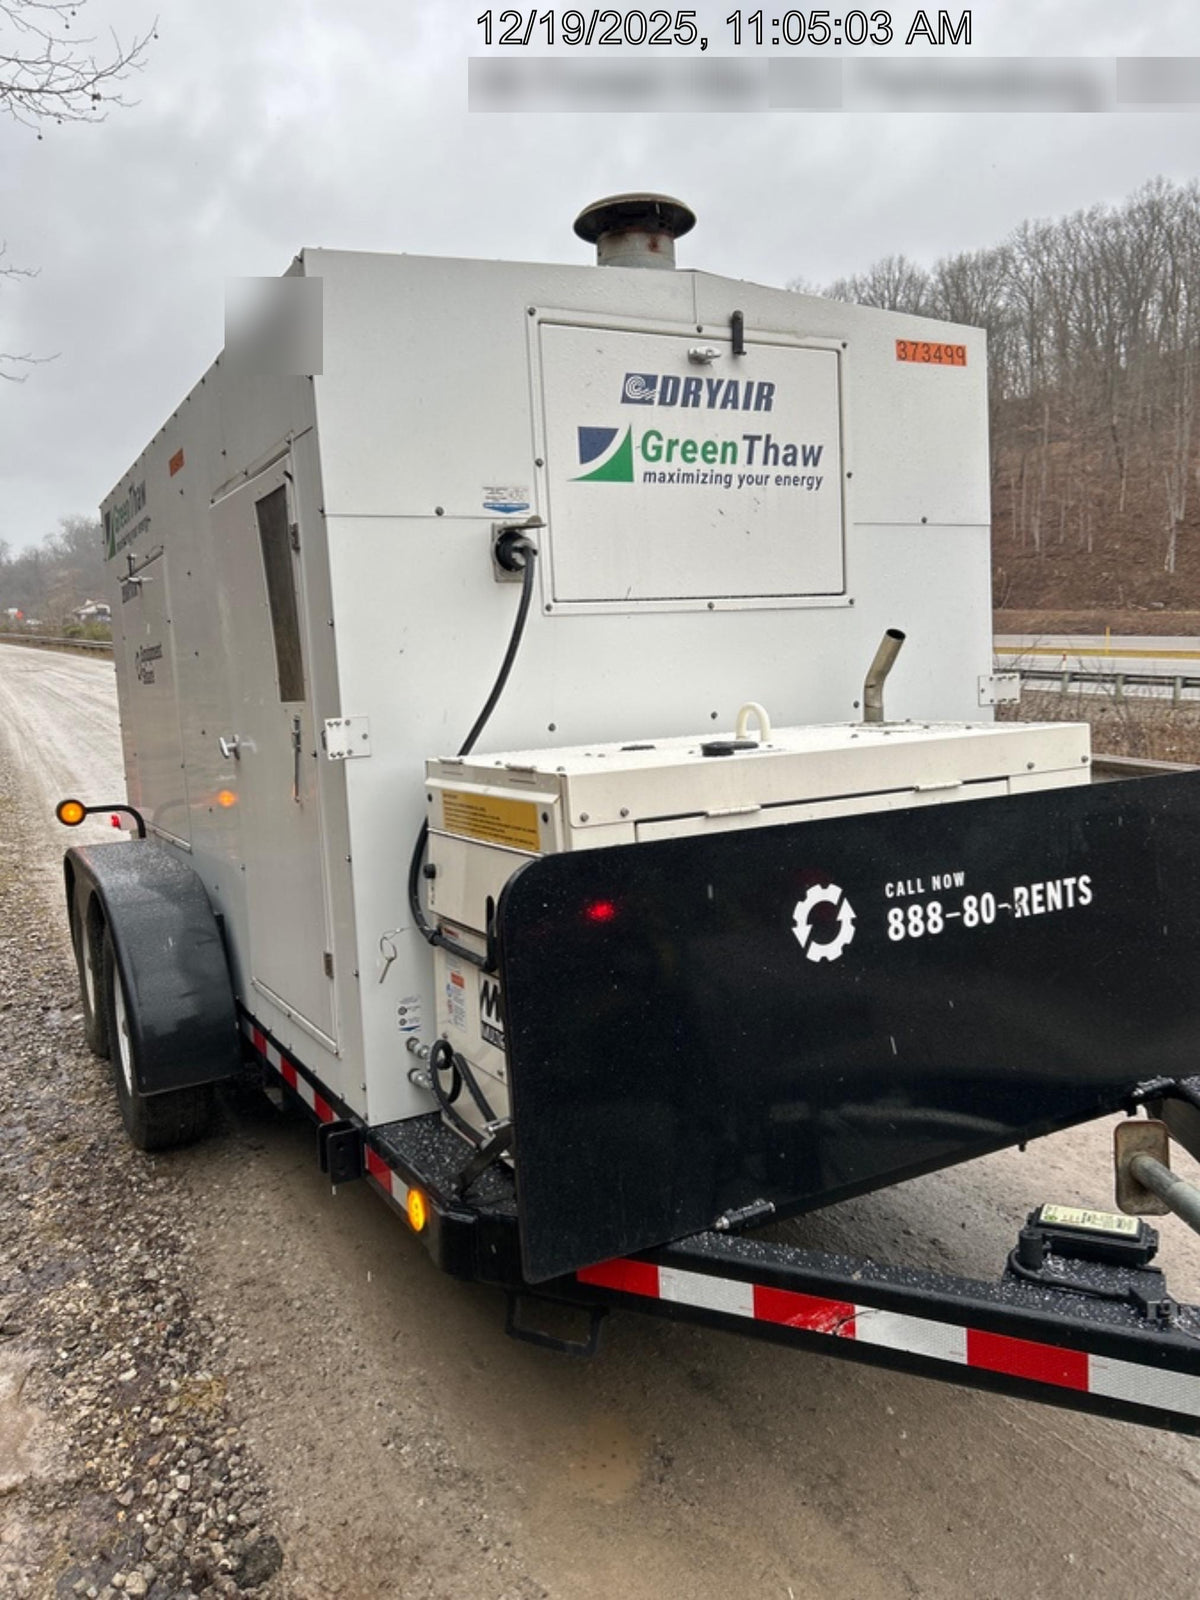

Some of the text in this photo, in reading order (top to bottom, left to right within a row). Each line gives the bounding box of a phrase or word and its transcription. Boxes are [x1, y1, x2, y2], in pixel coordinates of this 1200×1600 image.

[897, 340, 967, 367] 373499
[657, 374, 776, 412] DRYAIR
[642, 467, 824, 492] maximizing your energy
[884, 871, 966, 899] CALL NOW
[886, 873, 1094, 942] 888-80-RENTS
